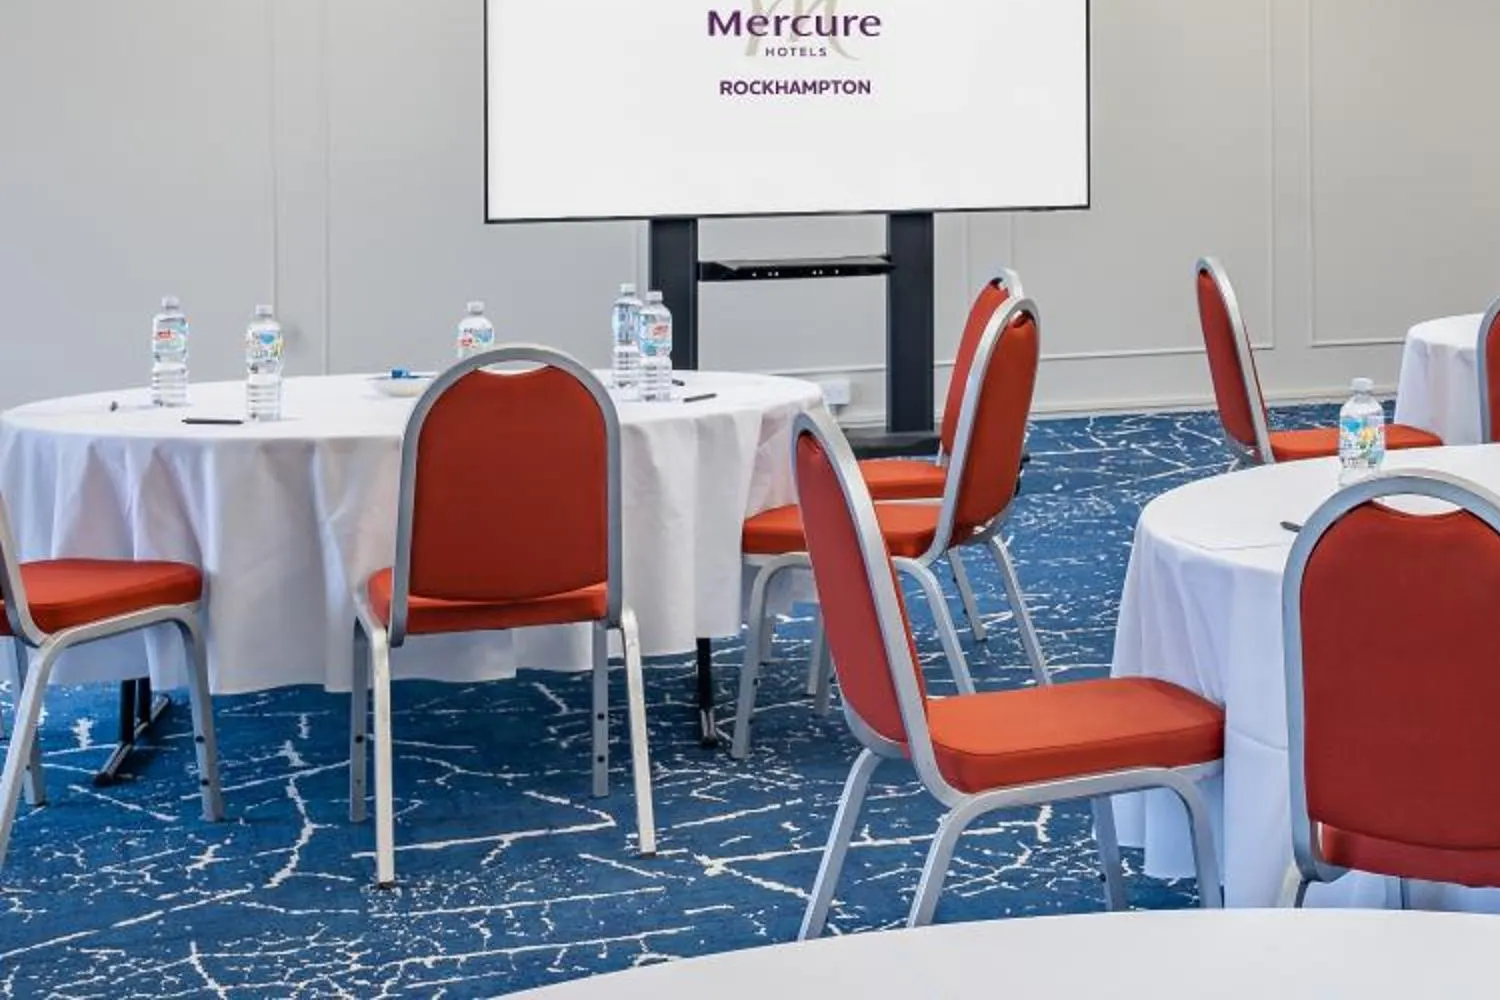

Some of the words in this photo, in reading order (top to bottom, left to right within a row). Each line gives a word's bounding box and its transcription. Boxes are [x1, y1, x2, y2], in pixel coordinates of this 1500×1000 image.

[708, 10, 881, 37] Mercure
[765, 47, 827, 57] HOTELS
[719, 80, 871, 96] ROCKHAMPTON
